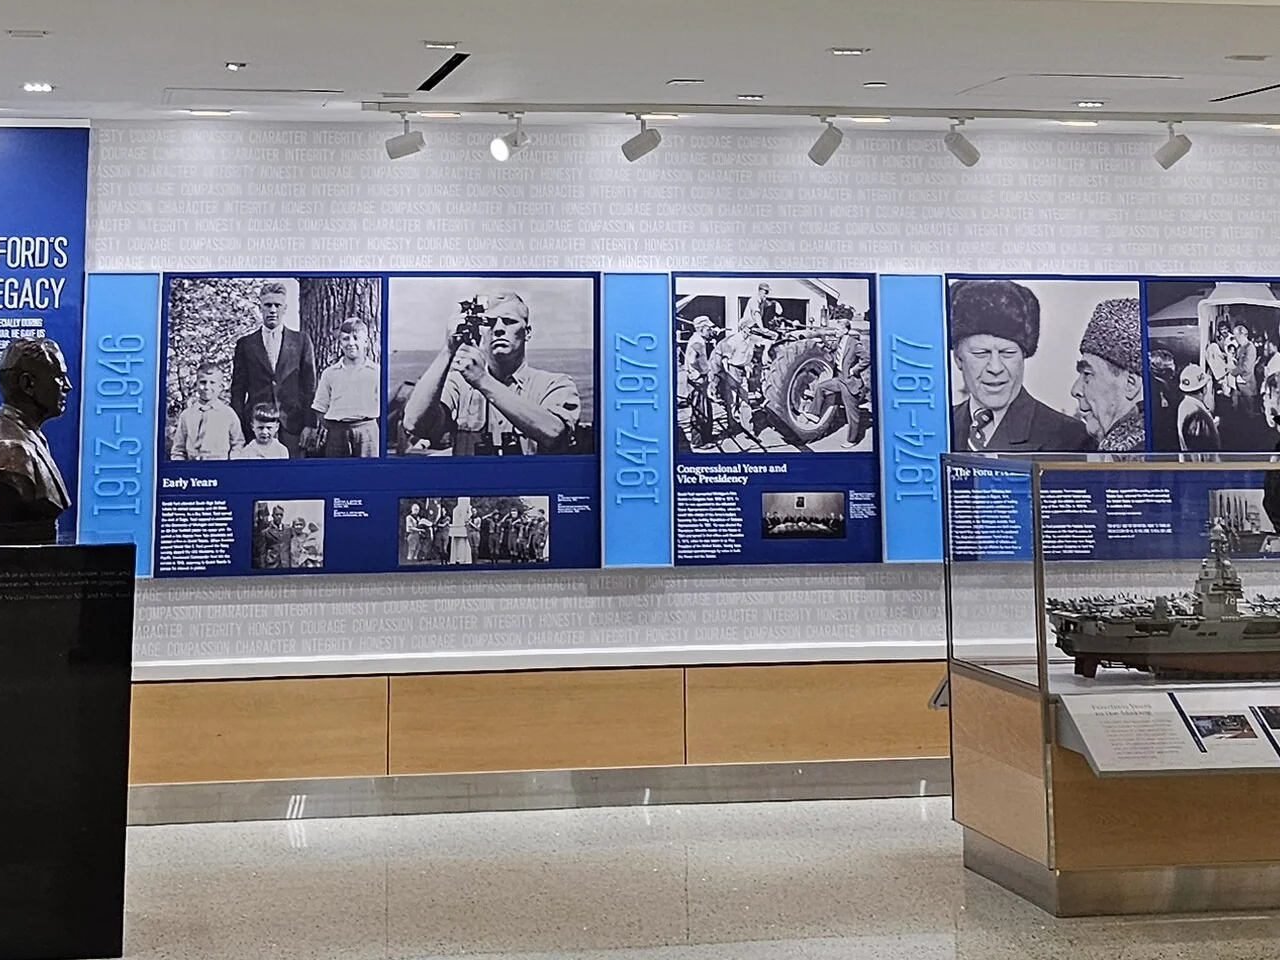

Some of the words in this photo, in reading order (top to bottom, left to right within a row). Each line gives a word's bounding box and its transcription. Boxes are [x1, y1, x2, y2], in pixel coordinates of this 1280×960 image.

[94, 334, 145, 516] 1913-1946
[615, 332, 659, 505] 1947-1973
[892, 333, 938, 502] 1974-1977
[162, 477, 188, 489] Early
[190, 478, 218, 487] Years
[677, 464, 741, 476] Congressional
[742, 464, 767, 473] Years
[769, 464, 787, 473] and
[677, 475, 697, 484] Vice
[699, 474, 748, 485] Presidency
